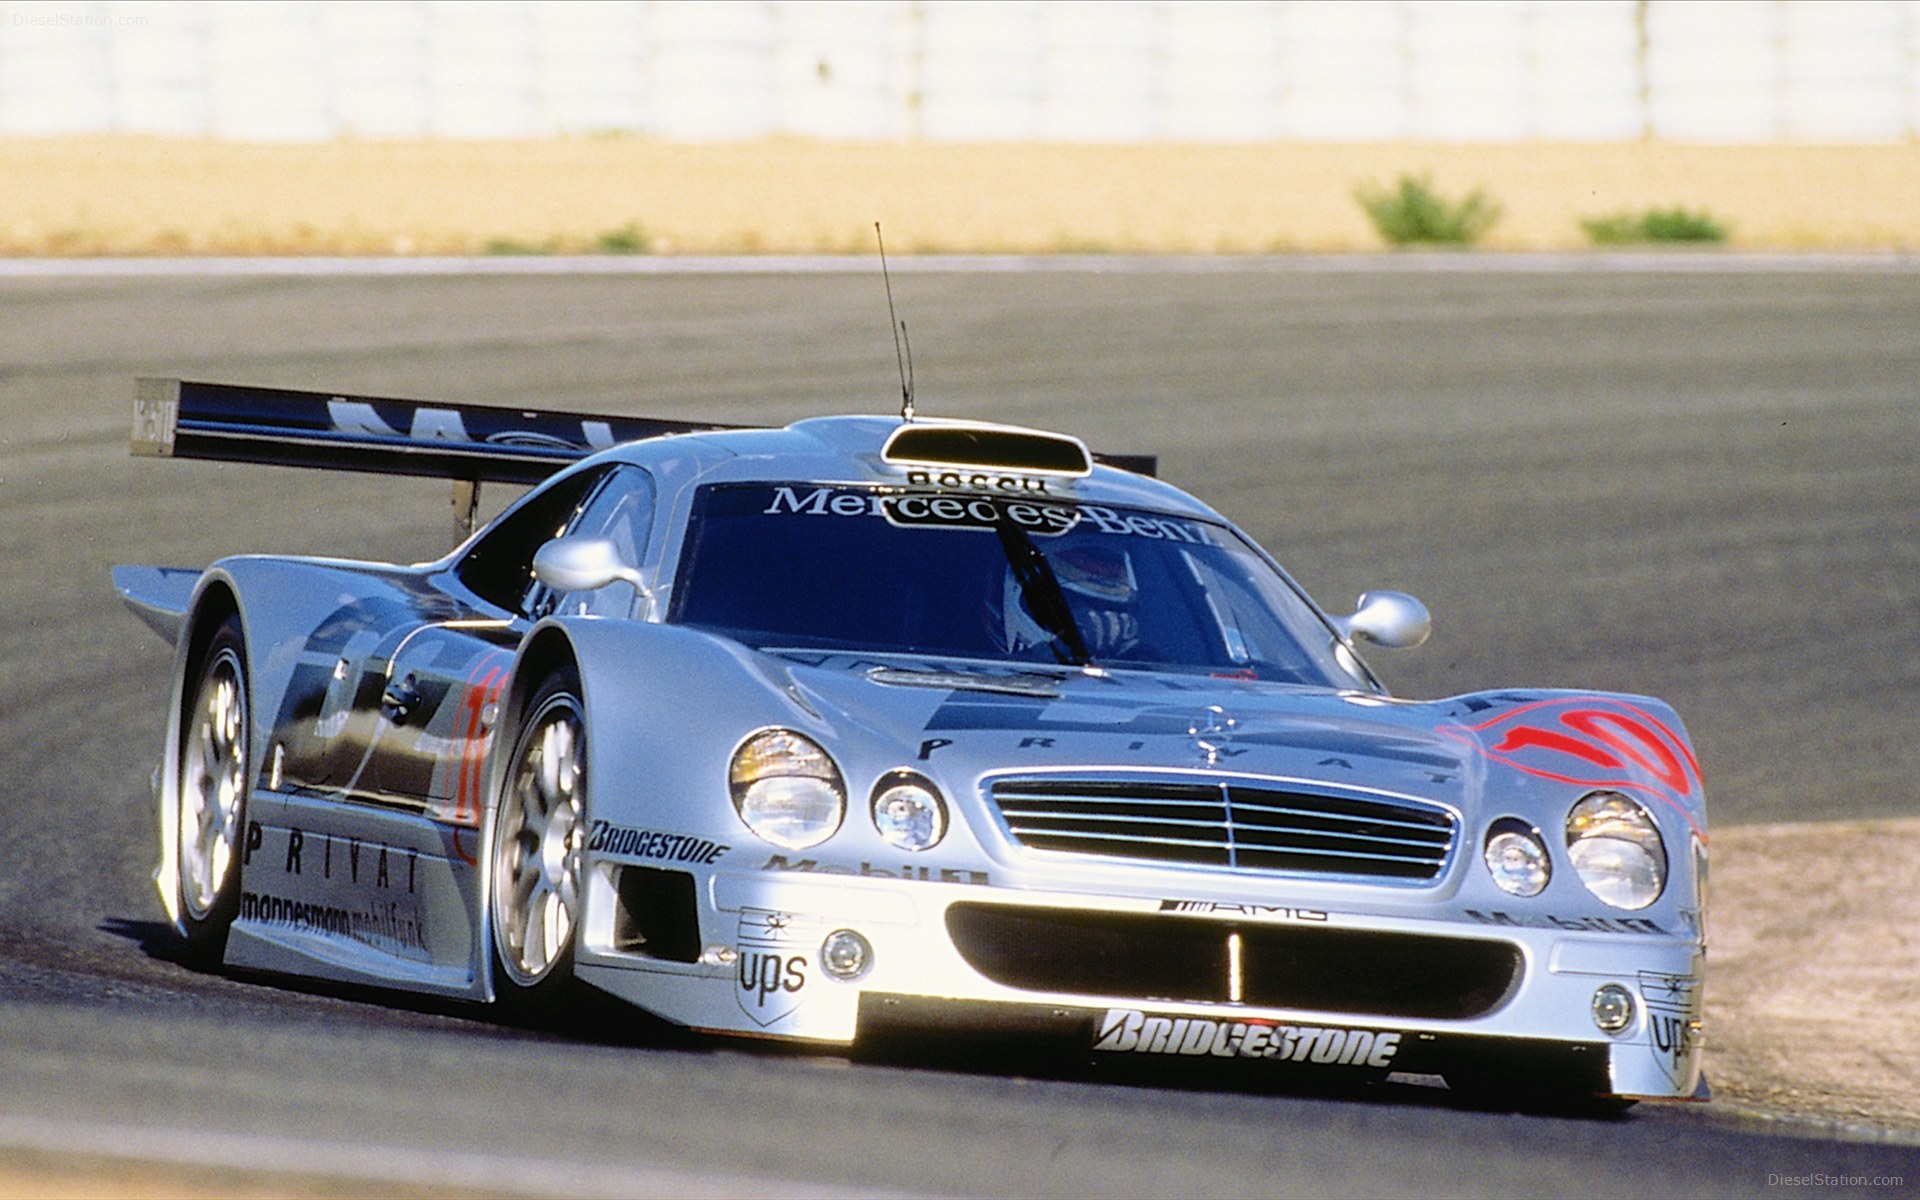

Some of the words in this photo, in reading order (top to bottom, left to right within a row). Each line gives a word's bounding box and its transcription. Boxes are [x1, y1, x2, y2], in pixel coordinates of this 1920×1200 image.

[1490, 709, 1691, 797] 10
[243, 820, 419, 894] PRIVAT
[588, 819, 733, 865] BRIDGESTONE
[1210, 901, 1328, 922] AMG
[739, 951, 808, 1007] ups
[1094, 1007, 1401, 1068] BRIDGESTONE
